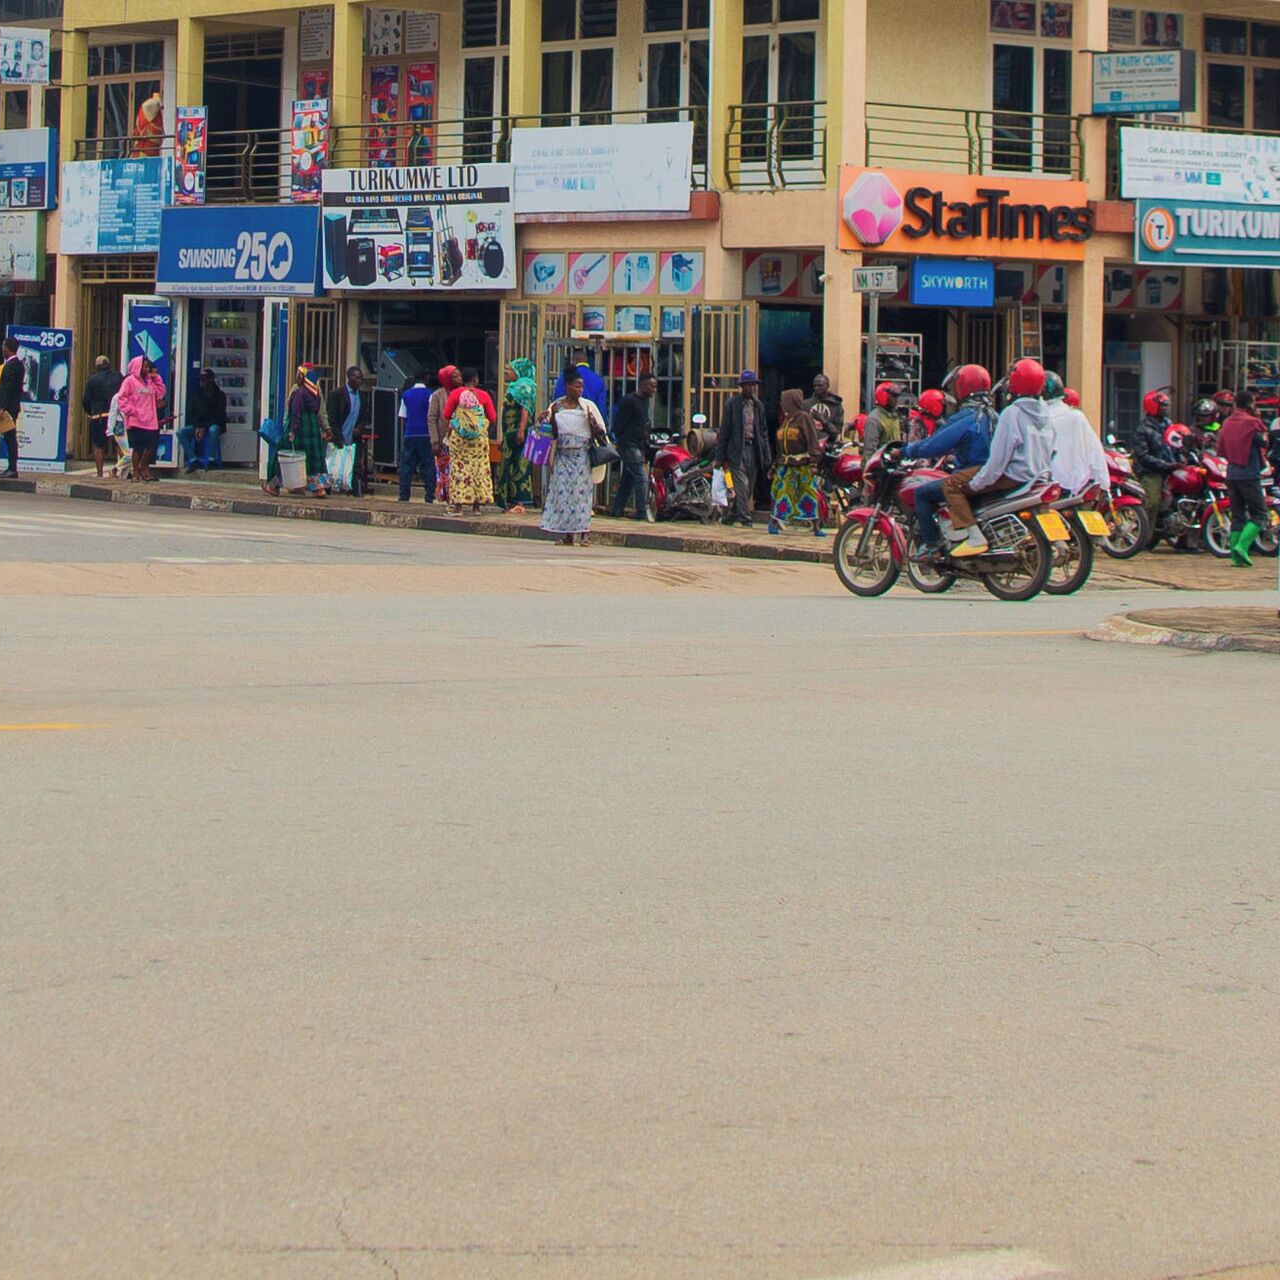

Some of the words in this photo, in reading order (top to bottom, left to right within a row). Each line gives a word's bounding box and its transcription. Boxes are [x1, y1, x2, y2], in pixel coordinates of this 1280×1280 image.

[1142, 53, 1175, 67] CLINIC
[349, 167, 443, 191] TURIKUMWE
[448, 165, 479, 189] LTD
[901, 186, 1095, 243] StarTimes
[178, 247, 236, 269] SAMSUNG
[234, 231, 294, 281] 250
[856, 275, 868, 288] NM
[871, 273, 884, 288] 157
[921, 274, 988, 290] SKYWORTH
[40, 331, 66, 347] 250
